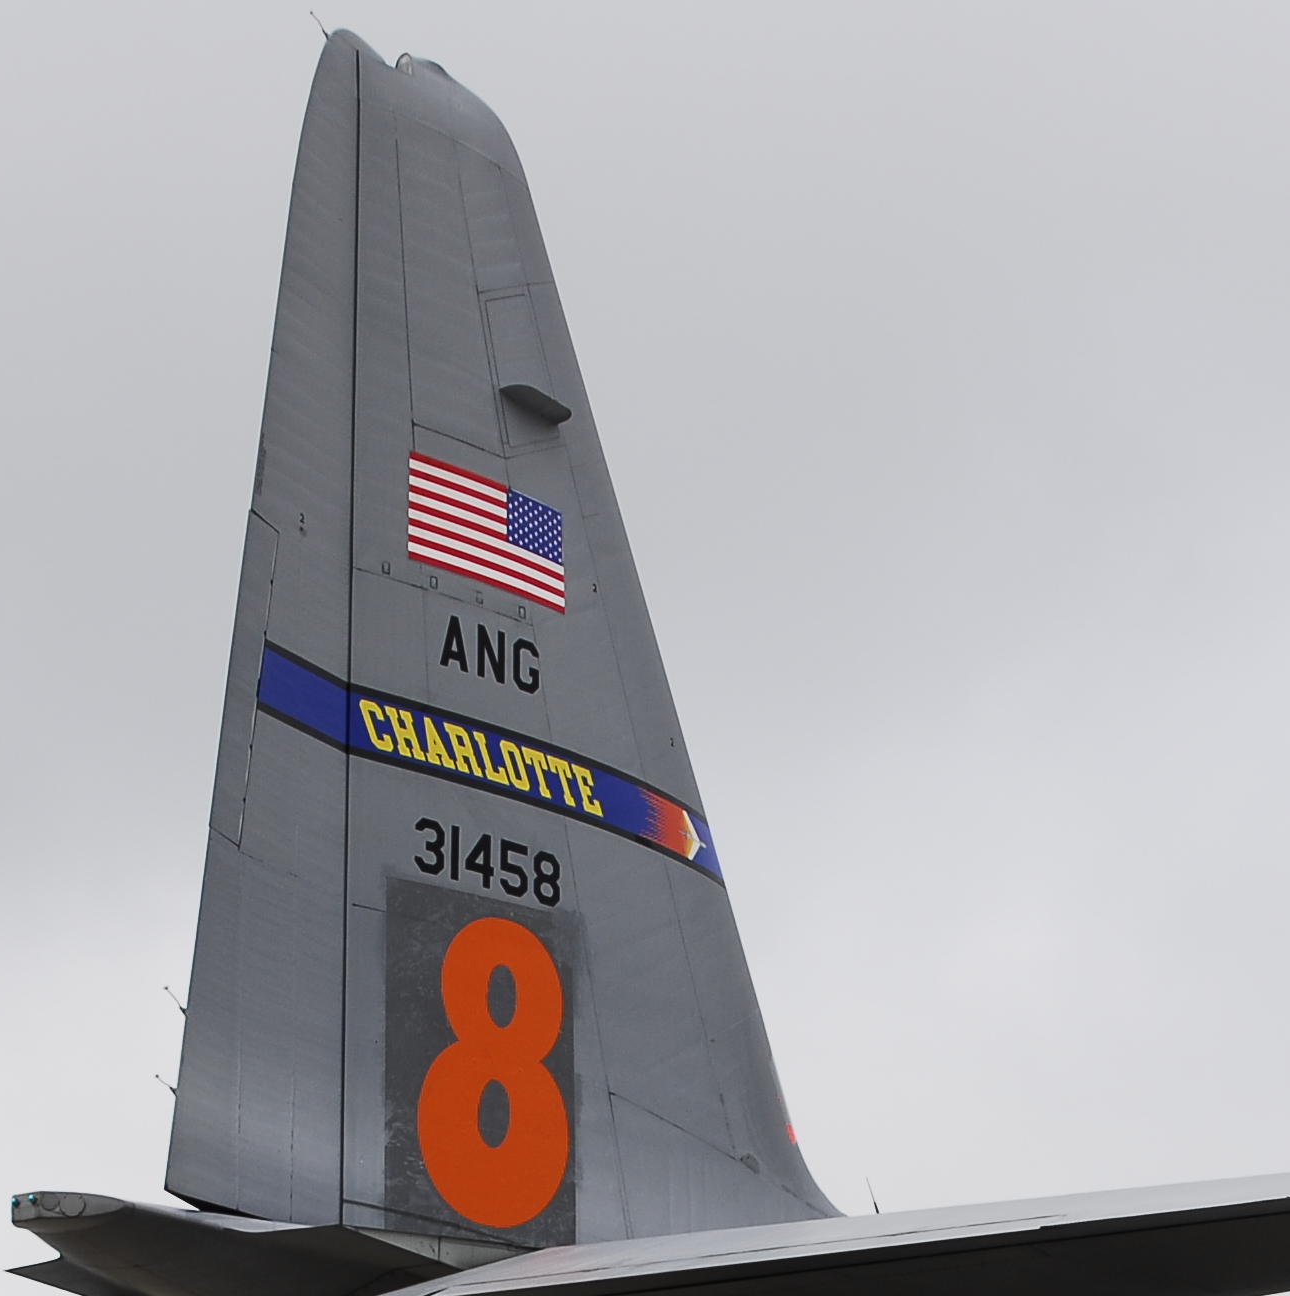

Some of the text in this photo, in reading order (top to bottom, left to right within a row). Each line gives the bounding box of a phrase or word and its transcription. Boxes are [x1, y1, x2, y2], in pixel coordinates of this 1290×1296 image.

[439, 614, 541, 695] ANG
[358, 698, 604, 817] CHARLOTTE
[413, 817, 562, 907] 31458
[416, 916, 569, 1229] 8
